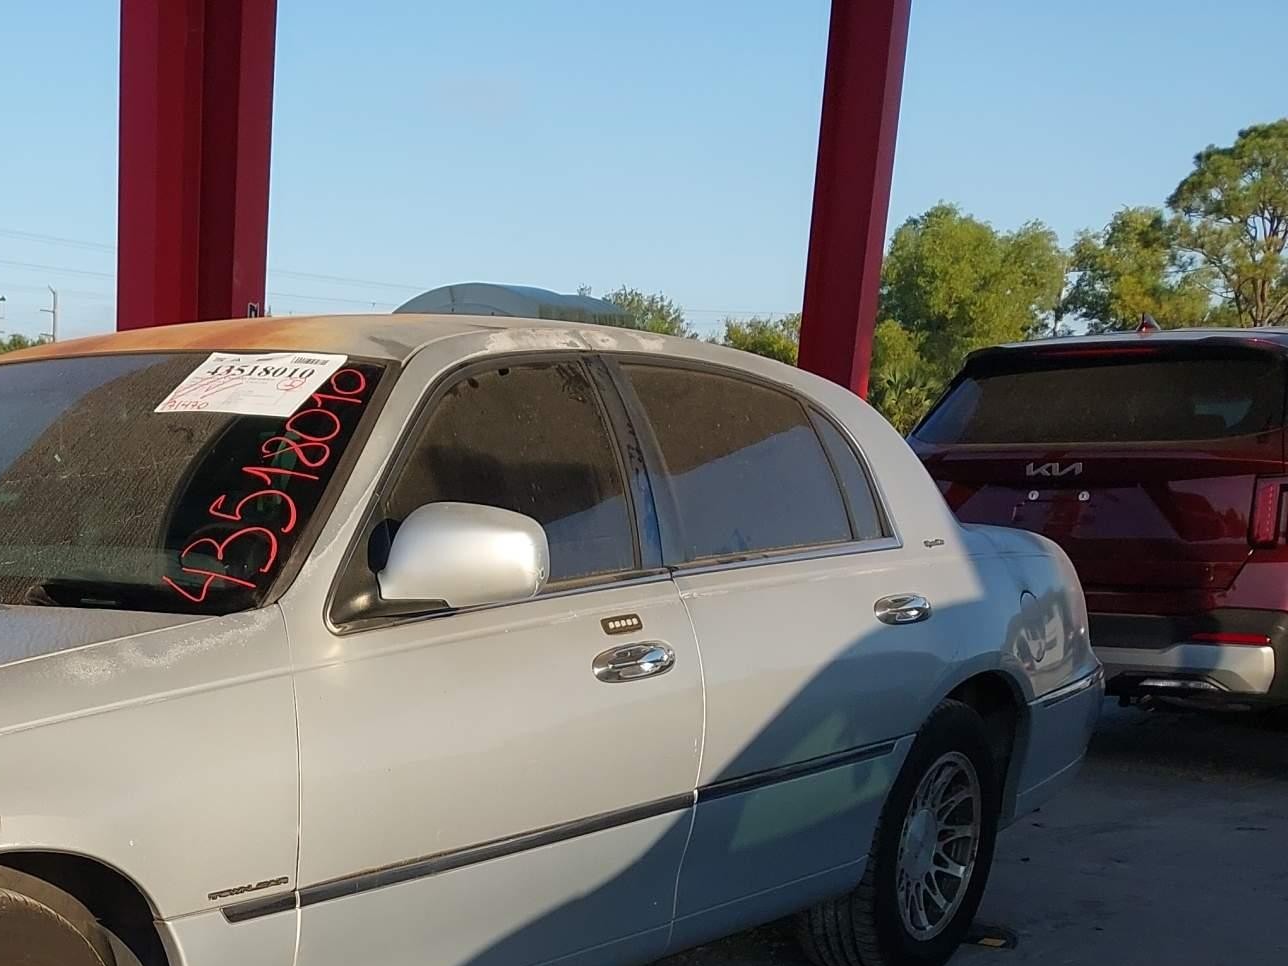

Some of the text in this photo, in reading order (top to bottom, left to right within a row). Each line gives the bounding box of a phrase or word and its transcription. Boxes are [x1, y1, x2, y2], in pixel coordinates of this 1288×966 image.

[207, 364, 316, 378] 43518010
[1025, 462, 1083, 476] KIA
[162, 368, 366, 602] 43518010
